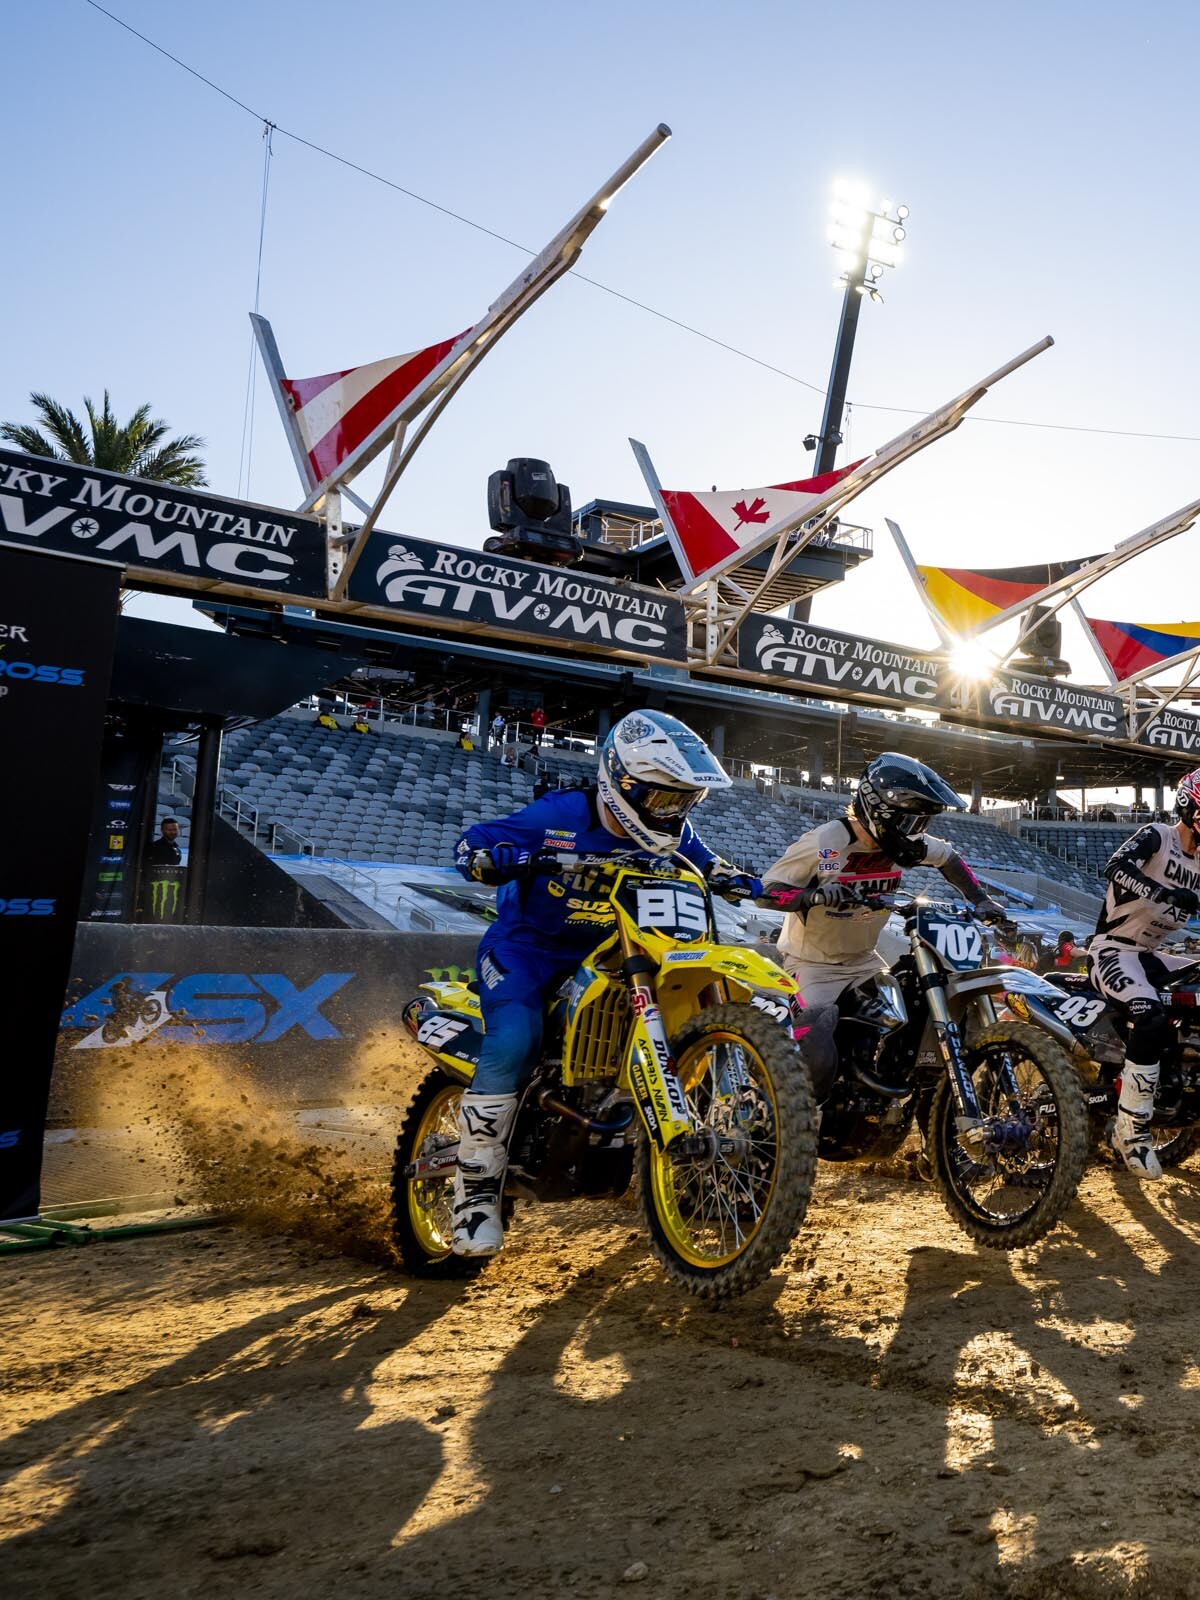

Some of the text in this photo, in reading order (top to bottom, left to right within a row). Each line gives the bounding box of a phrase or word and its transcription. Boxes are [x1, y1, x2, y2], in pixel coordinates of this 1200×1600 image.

[70, 477, 297, 547] MOUNTAIN
[430, 550, 668, 620] ROCKY MOUNTAIN
[788, 627, 938, 677] ROCKY MOUNTAIN
[1011, 678, 1115, 712] ROCKY MOUNTAIN
[1163, 712, 1197, 731] ROCKY
[818, 861, 840, 872] EBC
[1114, 868, 1151, 898] CANVAS
[636, 888, 709, 932] 85
[928, 923, 984, 962] 702
[1054, 996, 1106, 1027] 93
[417, 1015, 470, 1048] 85
[637, 1038, 658, 1085] ACERBIS
[653, 1038, 687, 1115] DUNLOP
